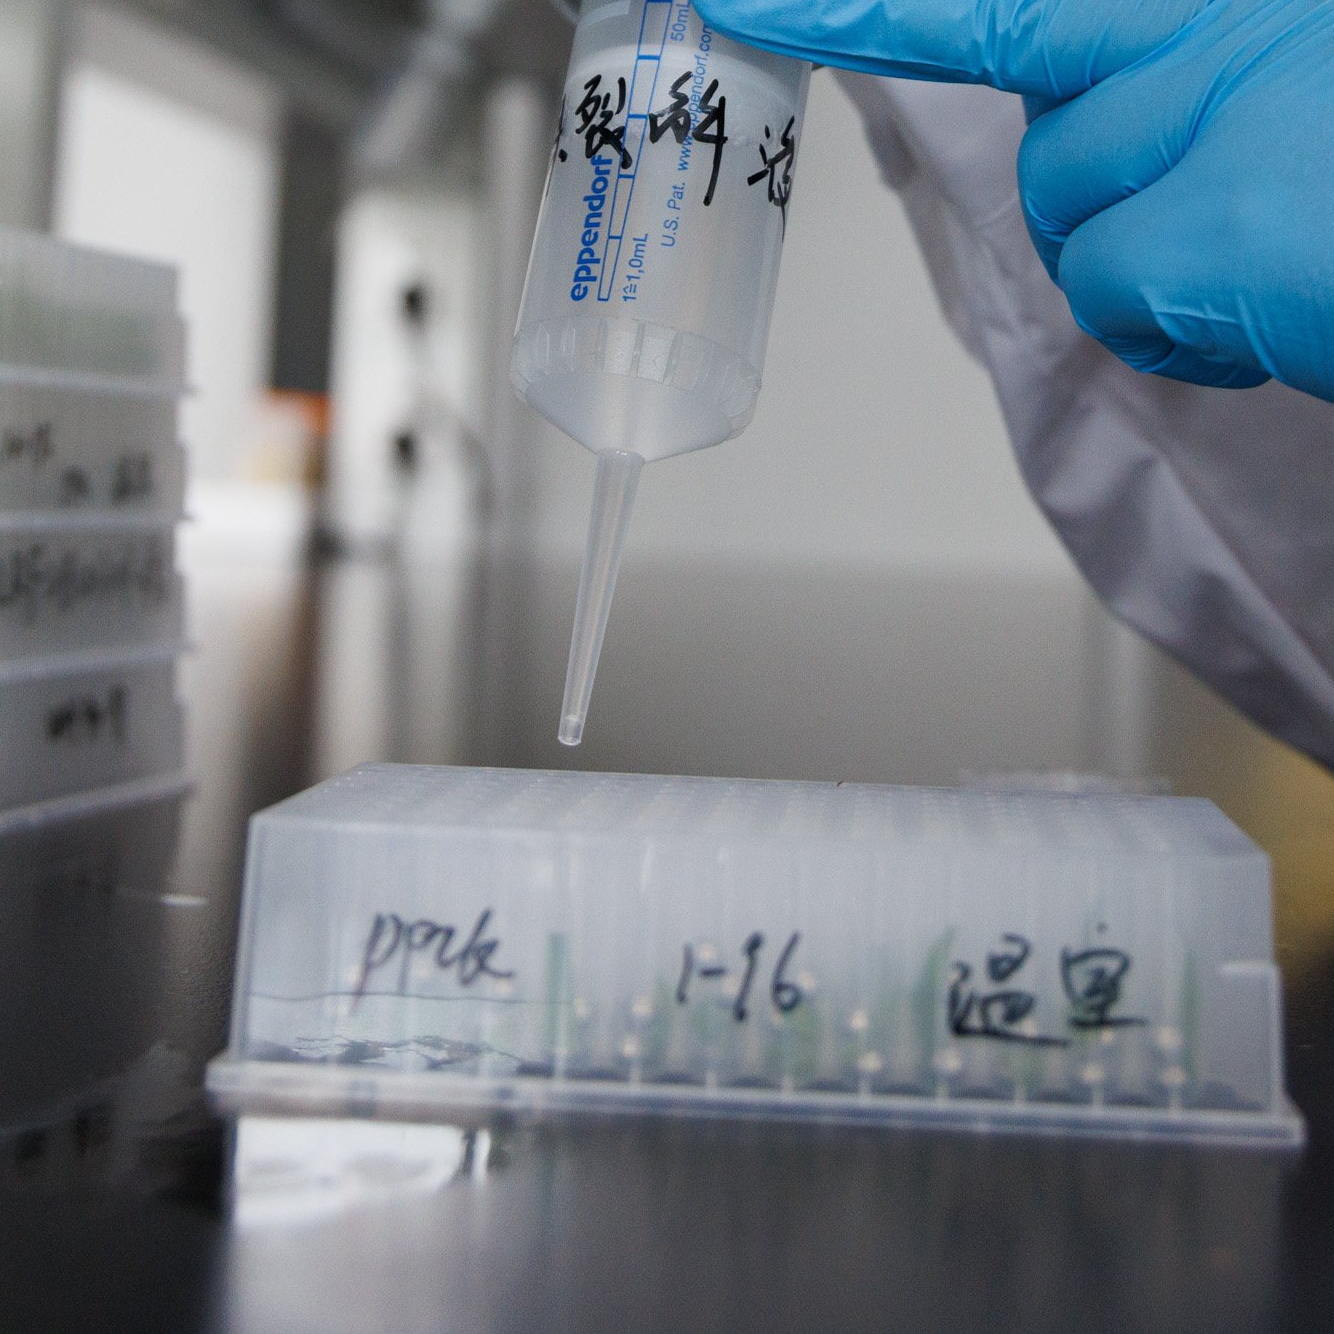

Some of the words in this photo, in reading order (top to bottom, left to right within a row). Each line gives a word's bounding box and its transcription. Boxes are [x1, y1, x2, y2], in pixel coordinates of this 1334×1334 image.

[570, 154, 614, 302] eppendorf
[660, 217, 679, 248] U.S.
[667, 182, 685, 211] Pat.
[676, 930, 803, 1022] 1-96
[947, 922, 1149, 1046] 温室
